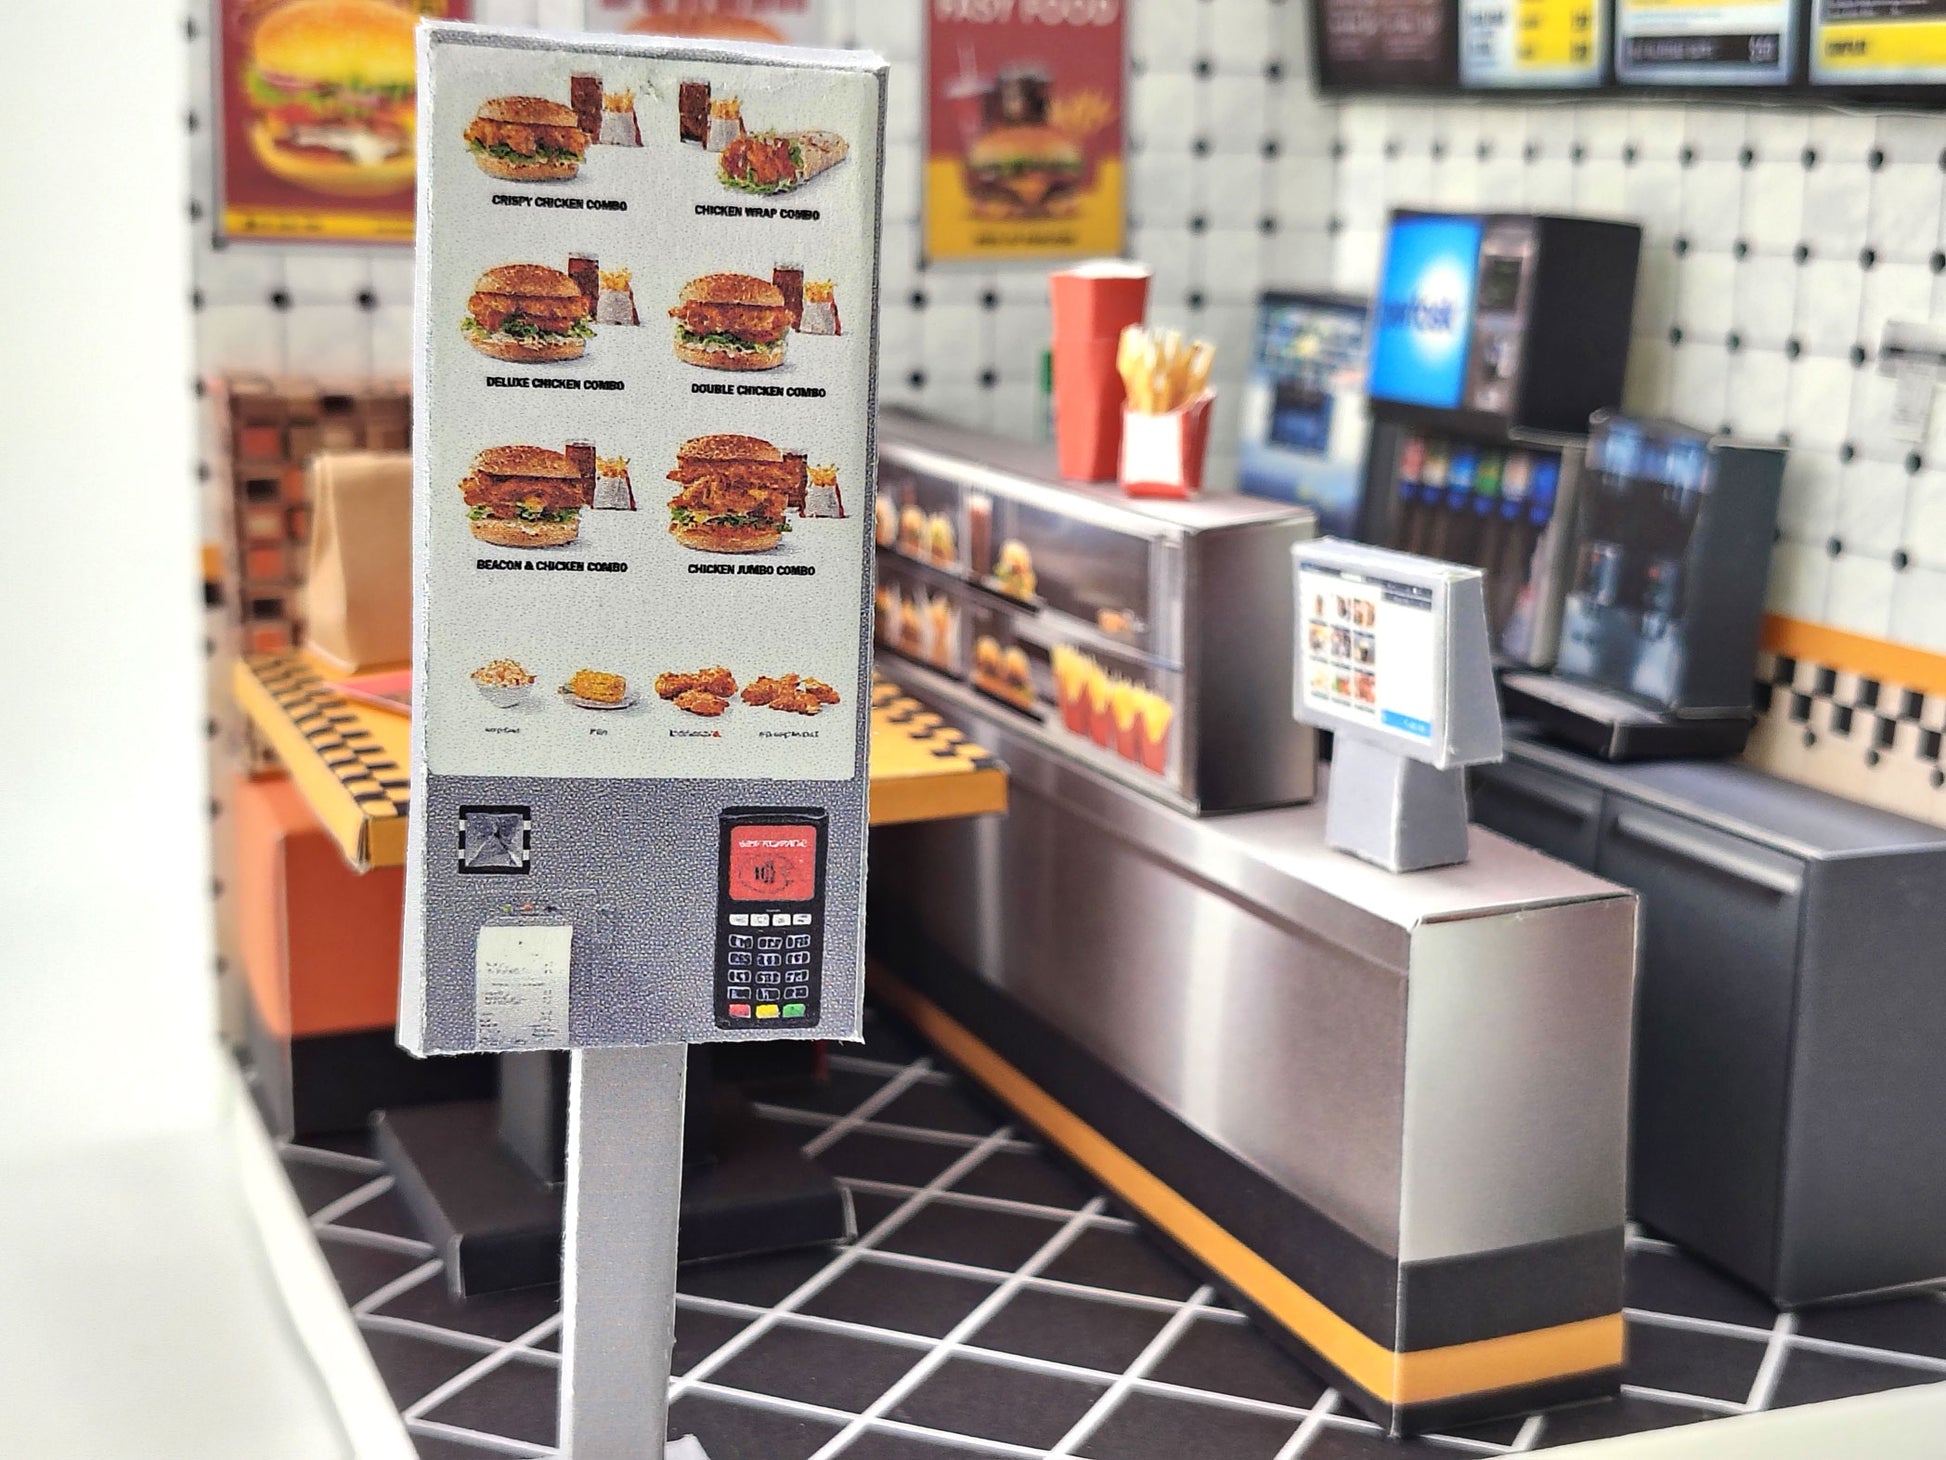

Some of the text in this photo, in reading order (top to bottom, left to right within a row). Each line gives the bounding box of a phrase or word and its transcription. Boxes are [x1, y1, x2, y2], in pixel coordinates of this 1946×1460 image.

[491, 194, 628, 211] CRISPY CHICKEN COMBO
[694, 204, 820, 221] CHICKEN WRAP COMBO
[486, 376, 625, 391] DELUXE CHICKEN COMBO
[691, 383, 827, 398] DOUBLE CHICKEN COMBO
[476, 559, 629, 573] BEACON & CHICKEN COMBO
[687, 563, 816, 576] CHICKEN JUMBO COMBO
